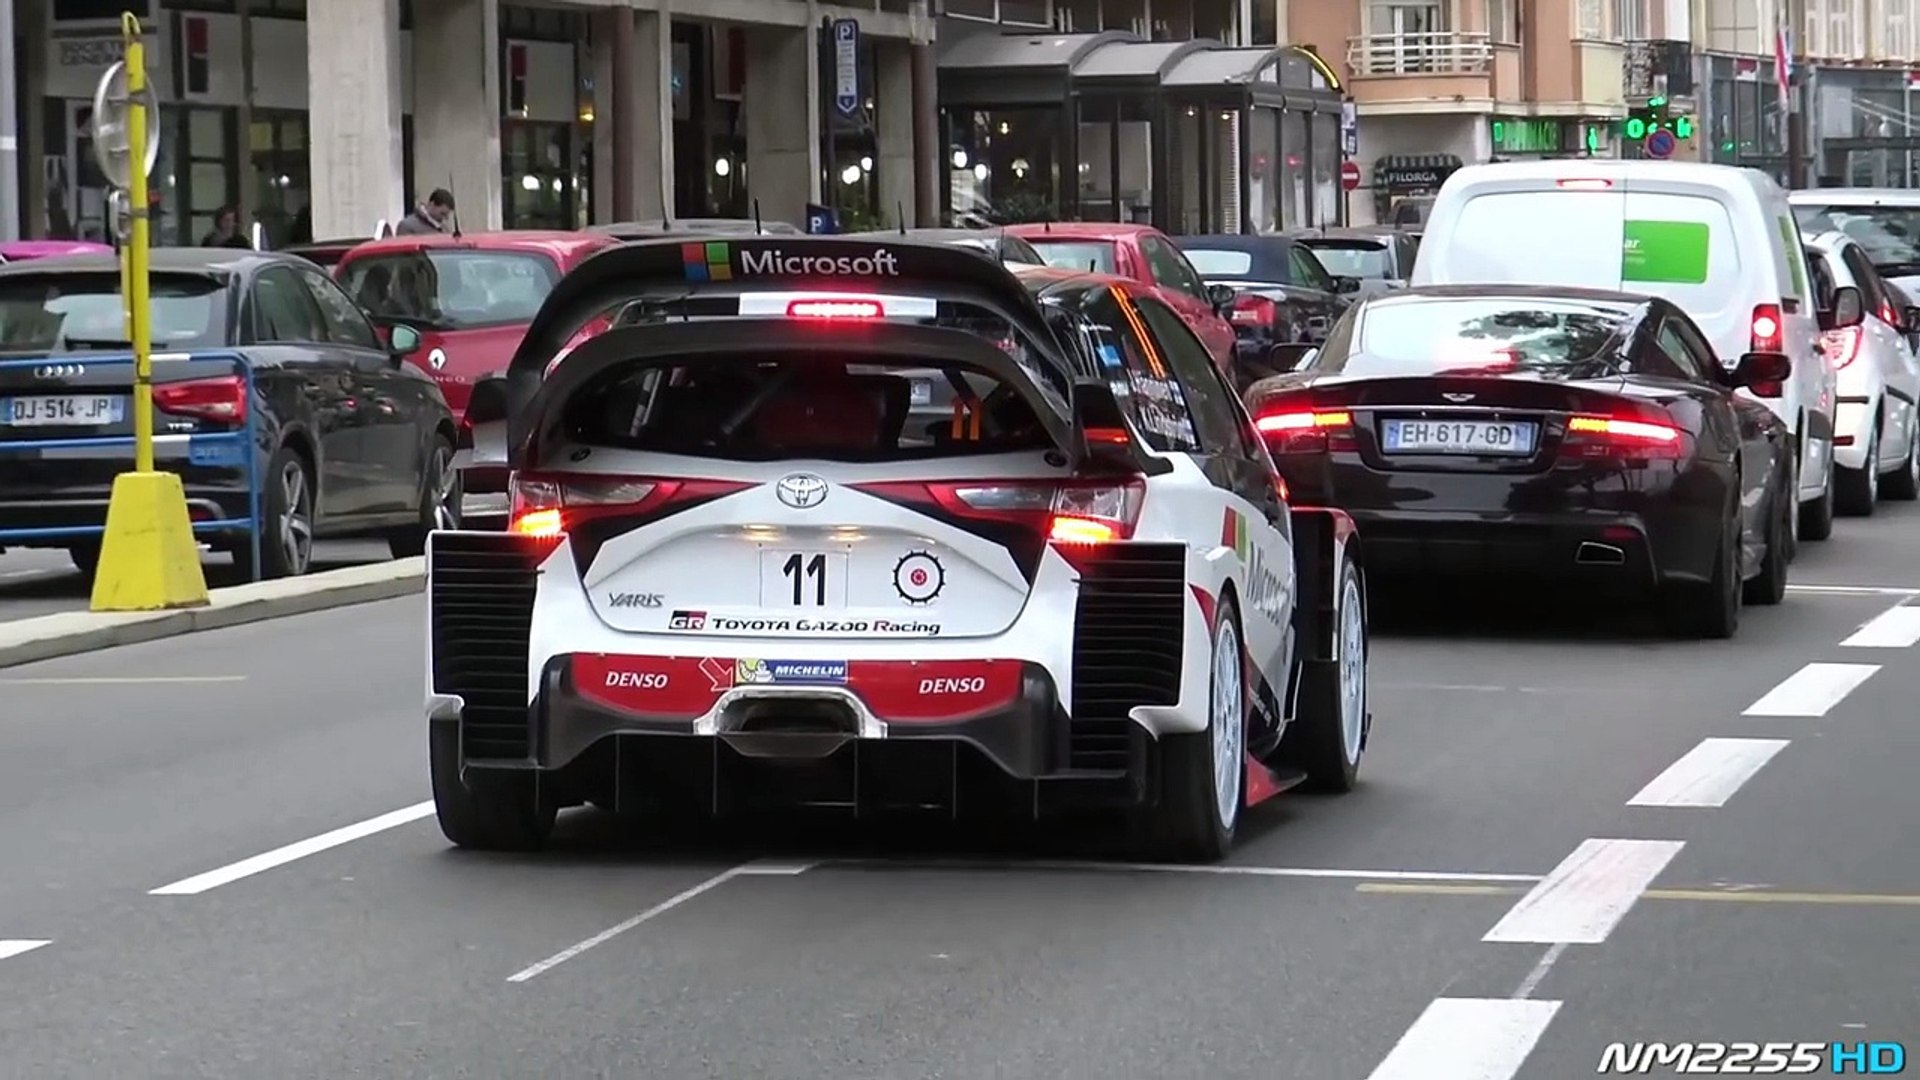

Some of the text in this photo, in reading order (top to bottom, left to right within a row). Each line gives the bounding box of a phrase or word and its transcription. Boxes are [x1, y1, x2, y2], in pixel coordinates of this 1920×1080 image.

[1388, 172, 1438, 183] FILORGA
[811, 215, 822, 233] P
[740, 249, 899, 276] Microsoft
[13, 398, 108, 420] DJ-514-JP
[1402, 423, 1512, 445] EH-617-GD
[783, 553, 827, 607] 11
[607, 592, 665, 608] YARIS
[669, 616, 705, 630] GR
[712, 617, 941, 636] TOYOTA GAZOO Racing
[775, 664, 844, 677] MICHELIN
[605, 671, 669, 689] DENSO
[919, 677, 985, 694] DENSO
